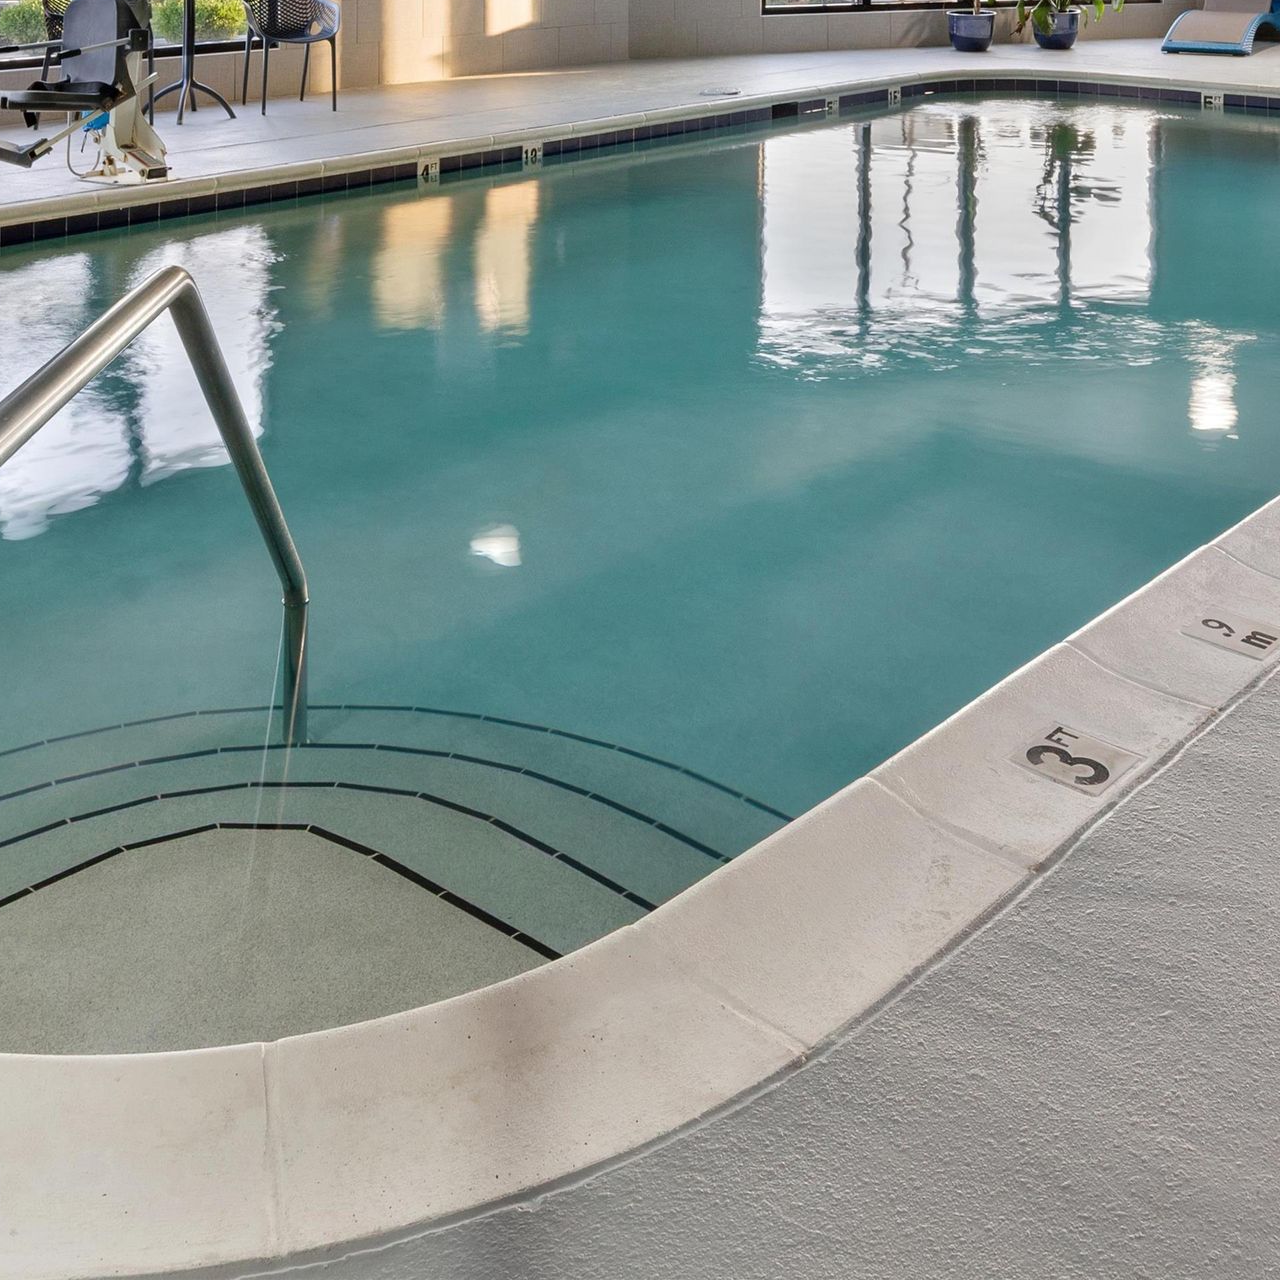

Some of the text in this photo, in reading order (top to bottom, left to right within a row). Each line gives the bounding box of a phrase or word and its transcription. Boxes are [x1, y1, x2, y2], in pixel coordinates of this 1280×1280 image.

[430, 162, 438, 171] FT
[1240, 629, 1279, 650] m
[1025, 725, 1110, 786] 3 FT
